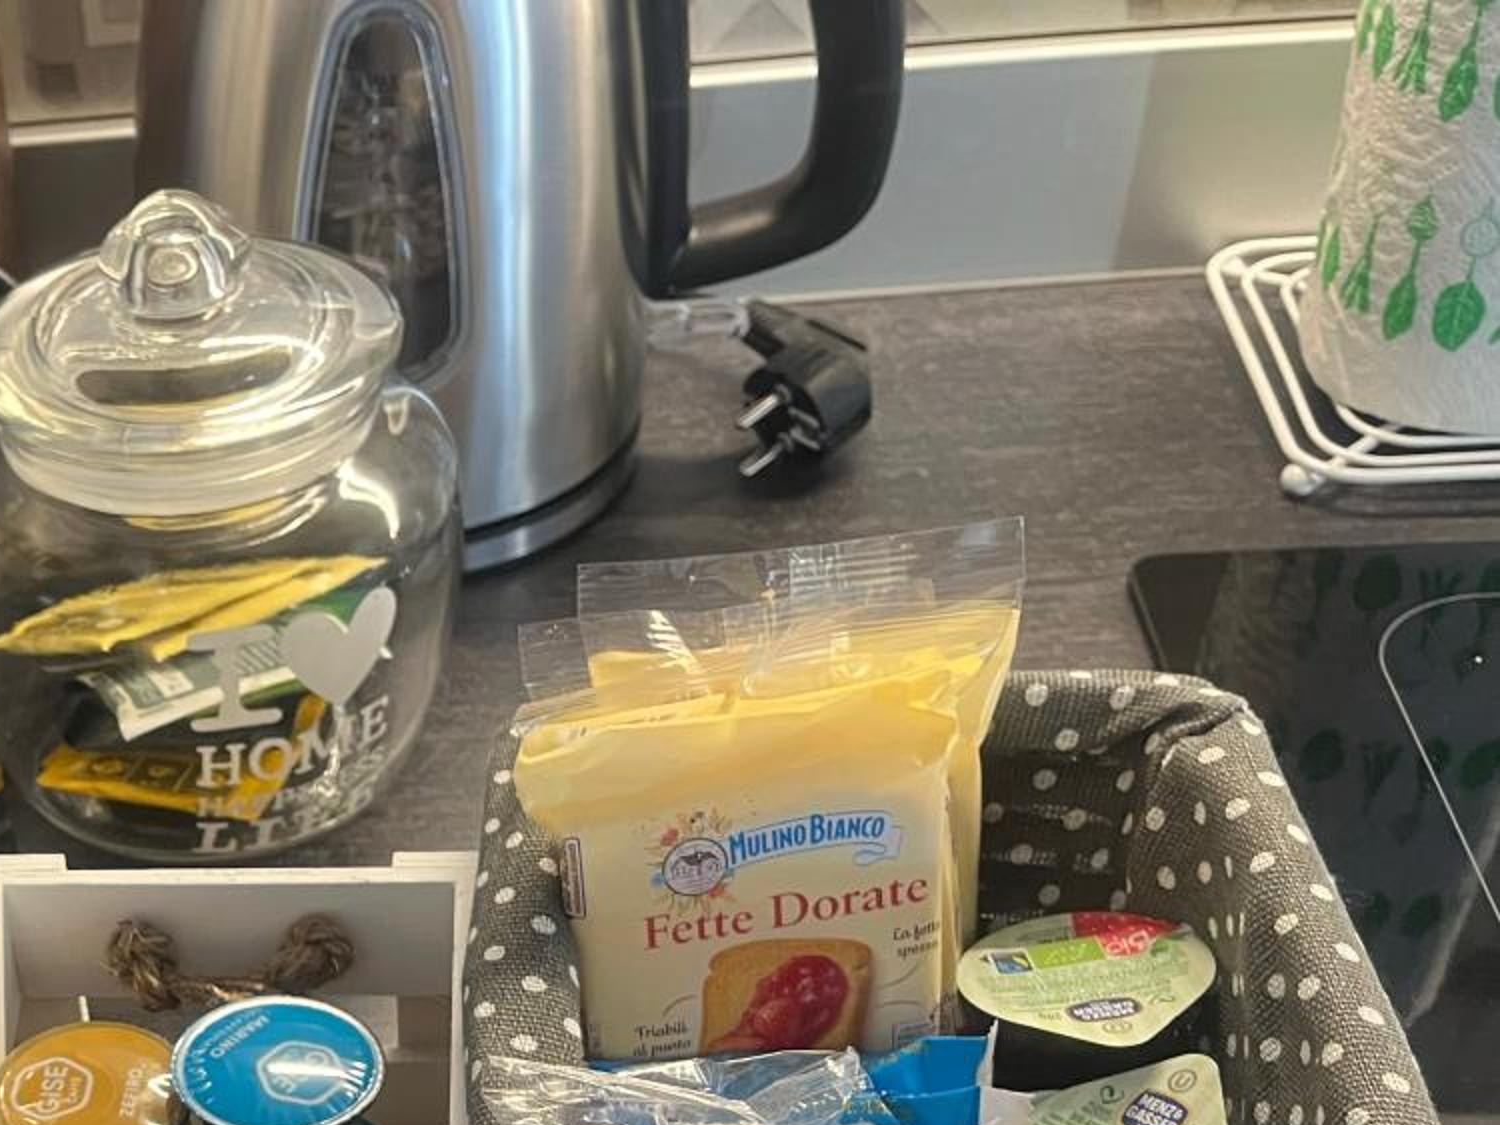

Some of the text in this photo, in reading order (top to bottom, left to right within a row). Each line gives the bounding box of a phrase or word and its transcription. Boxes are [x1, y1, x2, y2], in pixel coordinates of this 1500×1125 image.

[196, 695, 389, 790] HOME
[727, 814, 886, 865] MULINO BIANCO
[643, 877, 929, 950] Fette Dorate
